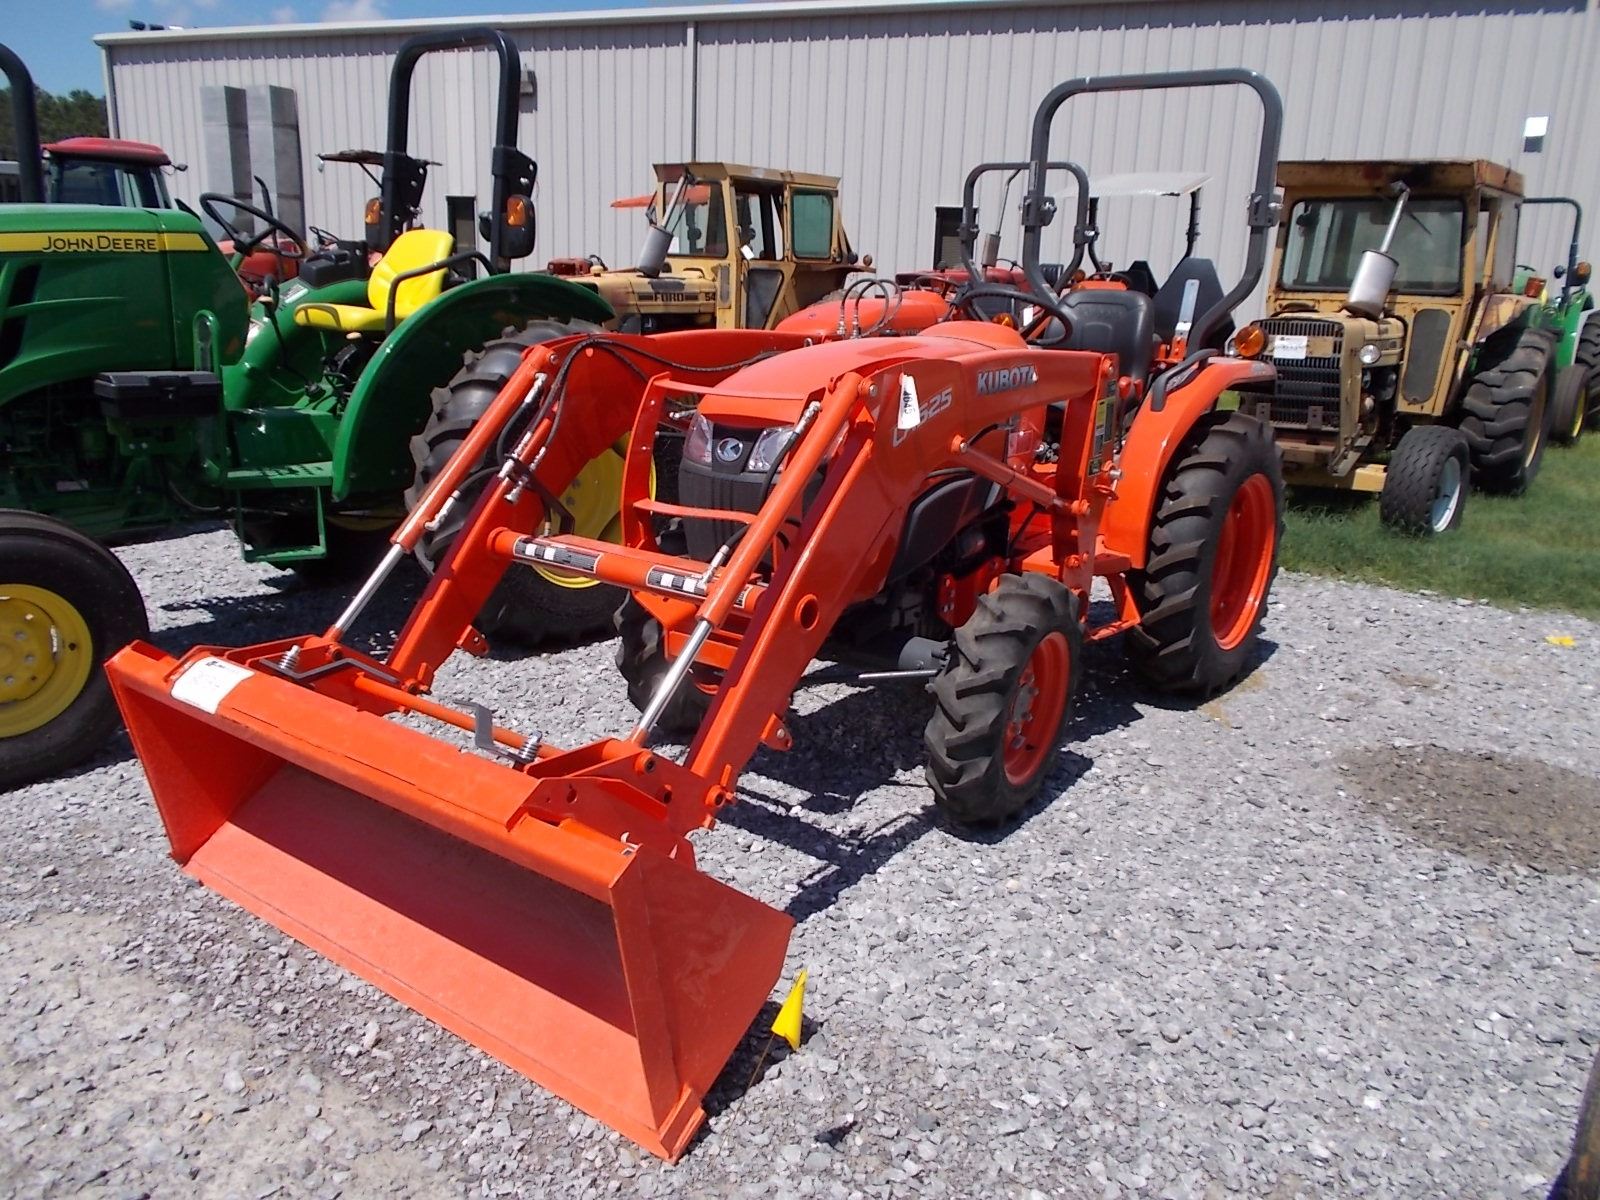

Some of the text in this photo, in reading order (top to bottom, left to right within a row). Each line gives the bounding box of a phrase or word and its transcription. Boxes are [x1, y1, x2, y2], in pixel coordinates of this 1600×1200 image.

[42, 236, 157, 250] JOHN DEERE
[653, 292, 685, 302] FORD
